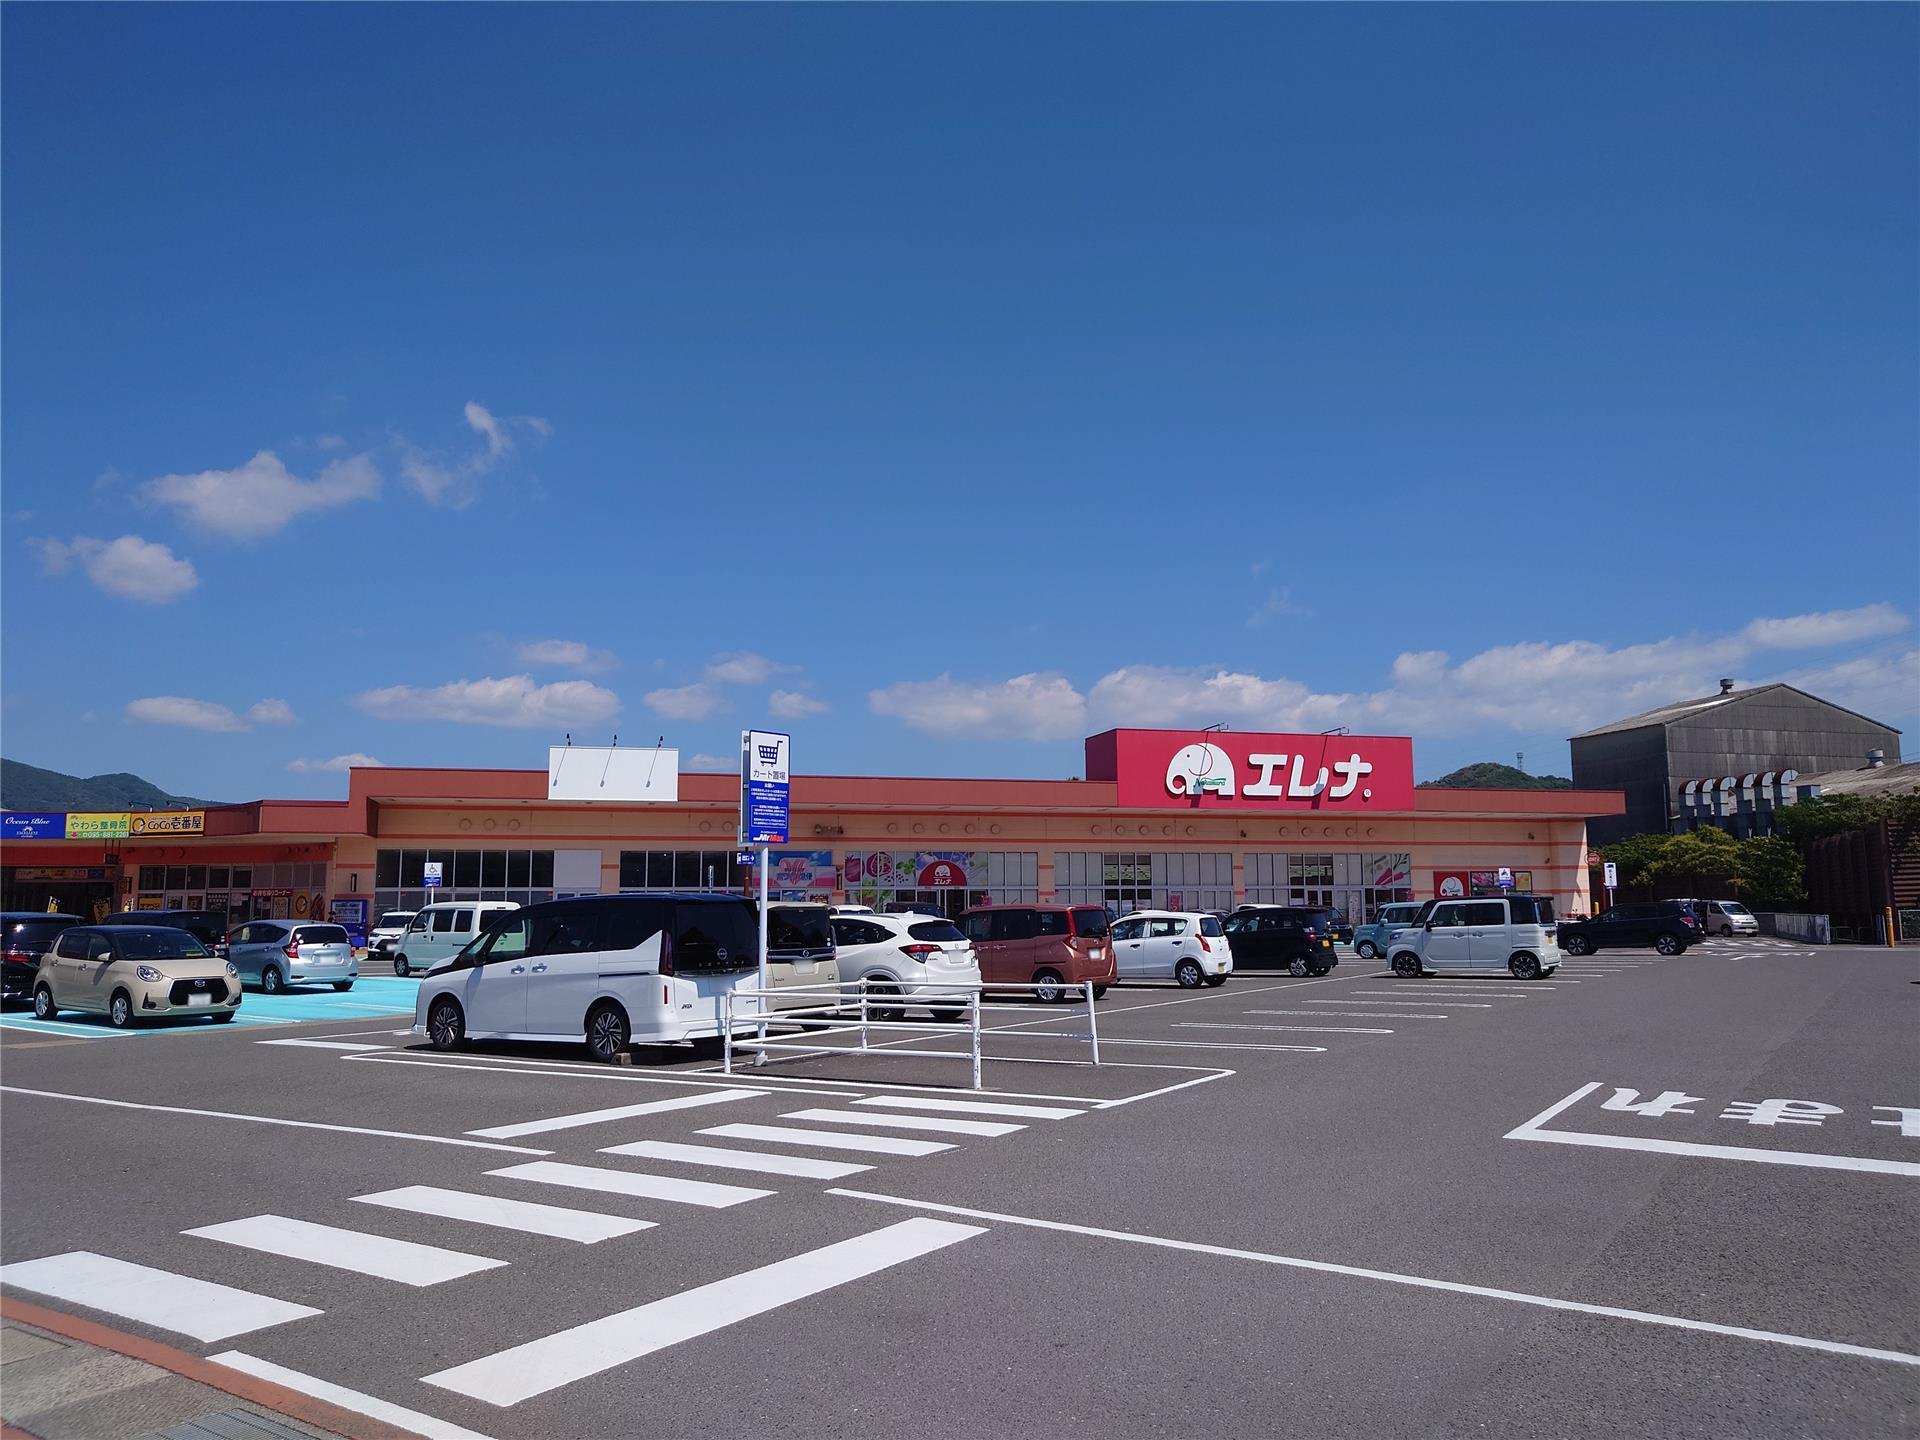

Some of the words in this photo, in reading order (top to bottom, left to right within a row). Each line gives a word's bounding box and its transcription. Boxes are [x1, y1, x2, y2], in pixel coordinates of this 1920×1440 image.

[753, 770, 786, 779] カート置場
[1242, 753, 1373, 798] エレナ
[5, 816, 30, 825] Ocean
[147, 815, 202, 830] CoCo壱番屋
